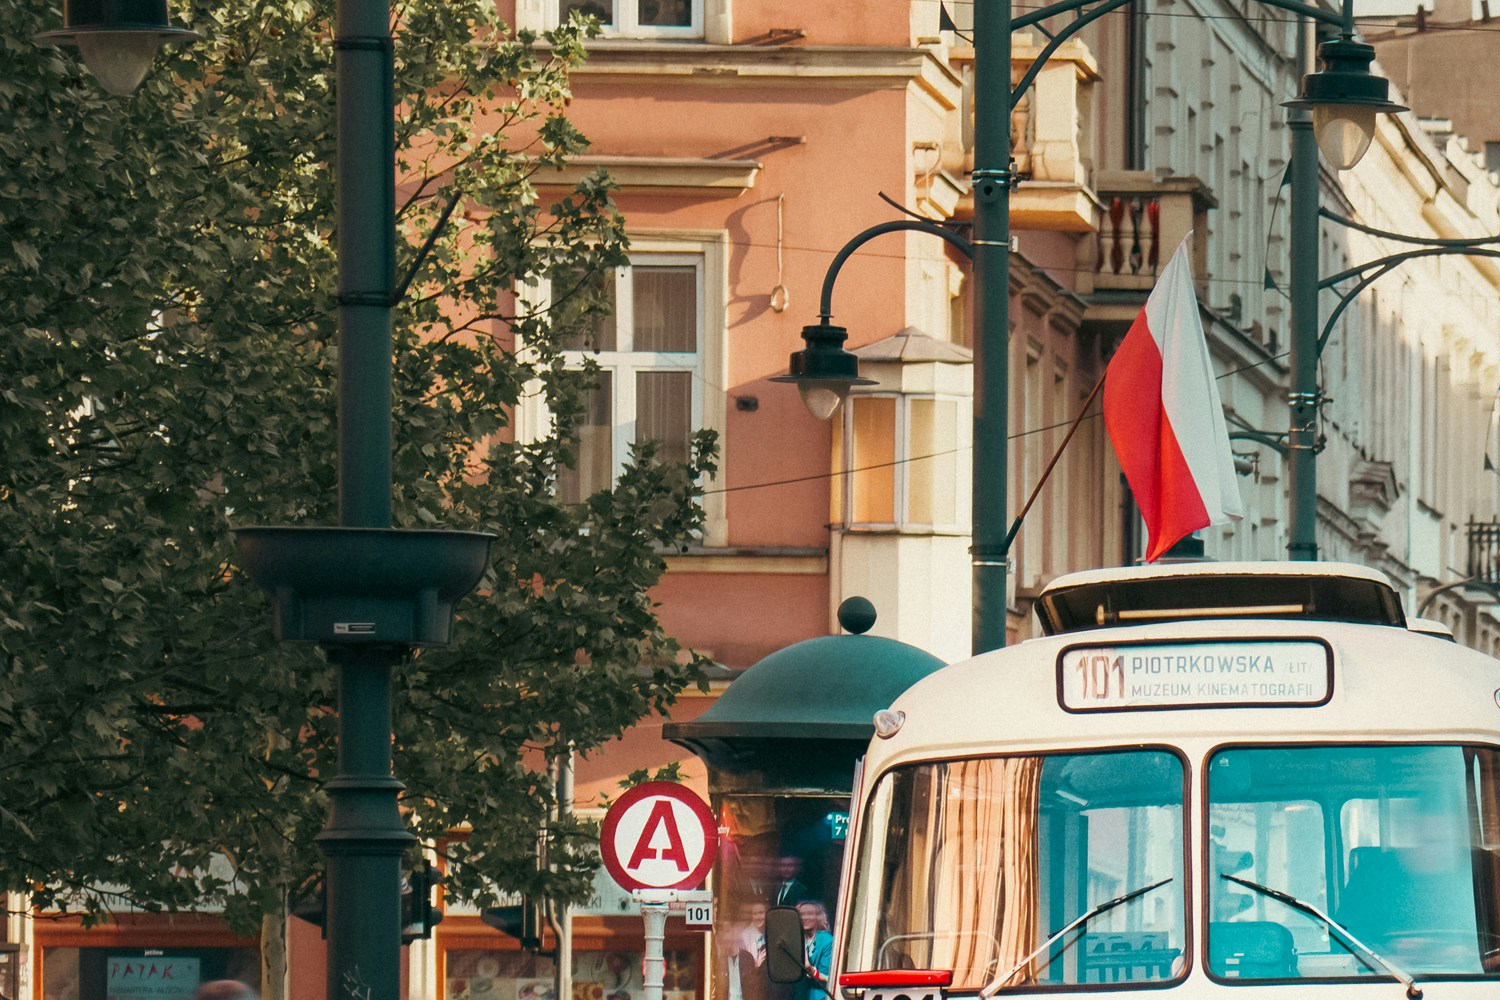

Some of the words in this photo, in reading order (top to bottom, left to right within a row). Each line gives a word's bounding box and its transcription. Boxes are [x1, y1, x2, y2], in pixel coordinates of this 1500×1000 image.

[1132, 655, 1275, 674] PIOTRKOWSKA
[1076, 655, 1125, 700] 101
[1132, 682, 1192, 697] MUZEUM
[1197, 682, 1313, 697] KINEMATOGRAFII
[627, 800, 690, 872] A
[687, 907, 710, 921] 101
